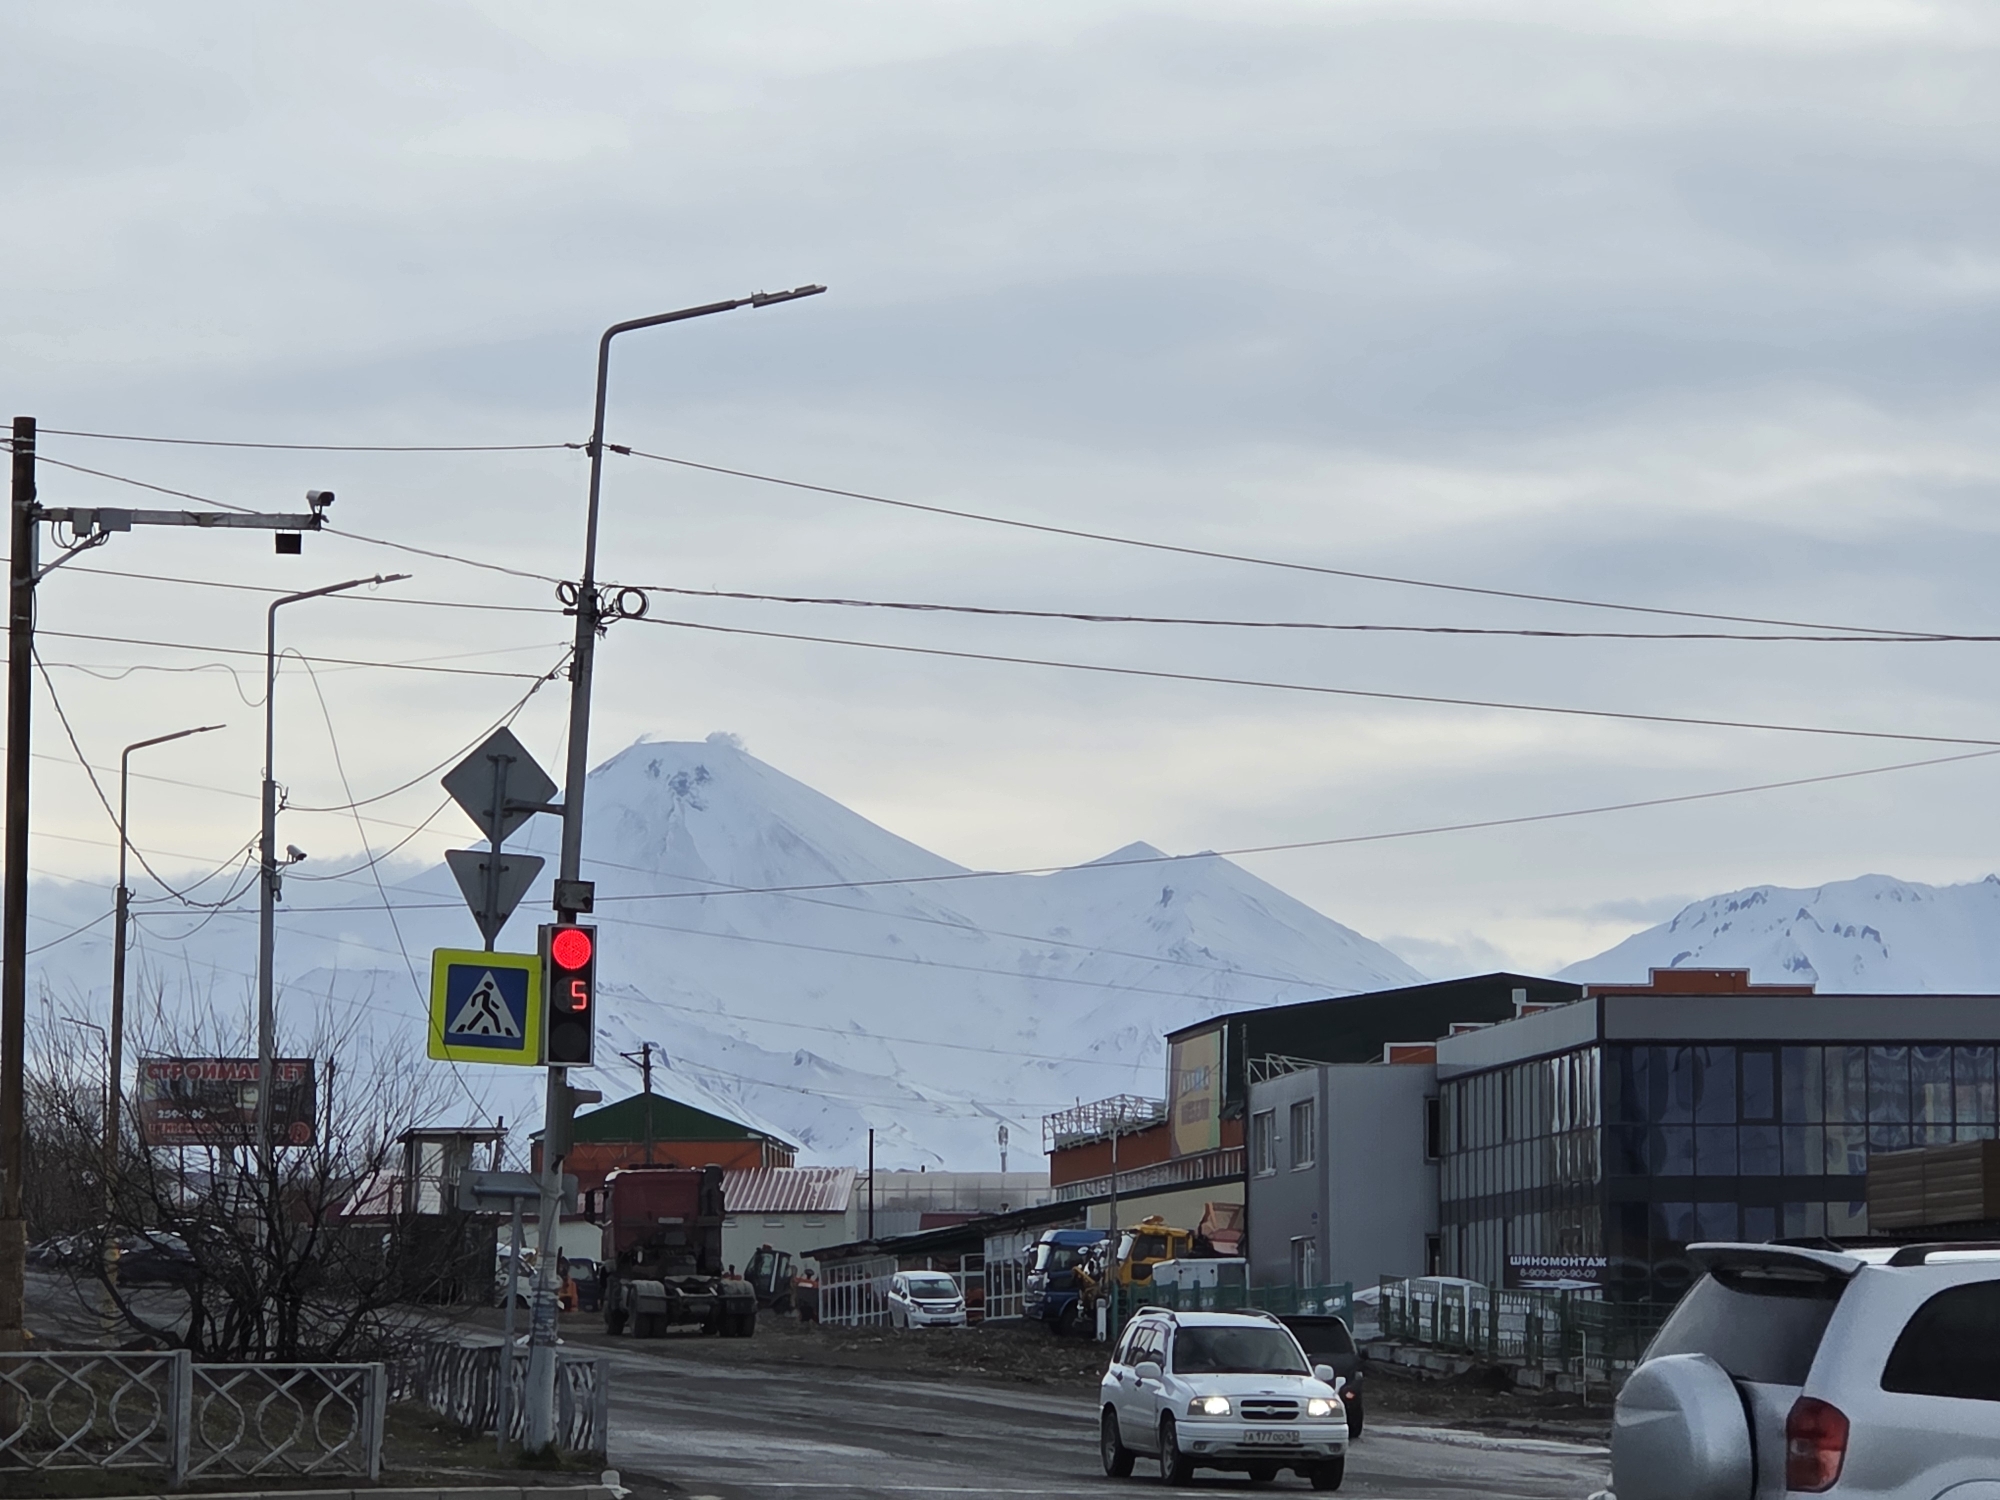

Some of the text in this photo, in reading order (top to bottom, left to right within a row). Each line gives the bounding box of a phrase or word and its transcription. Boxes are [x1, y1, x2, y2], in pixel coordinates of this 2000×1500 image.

[571, 980, 587, 1010] 5
[147, 1058, 307, 1081] СТРОЙМАЕТ
[1510, 1256, 1607, 1266] ШИНОМОНТАЖ
